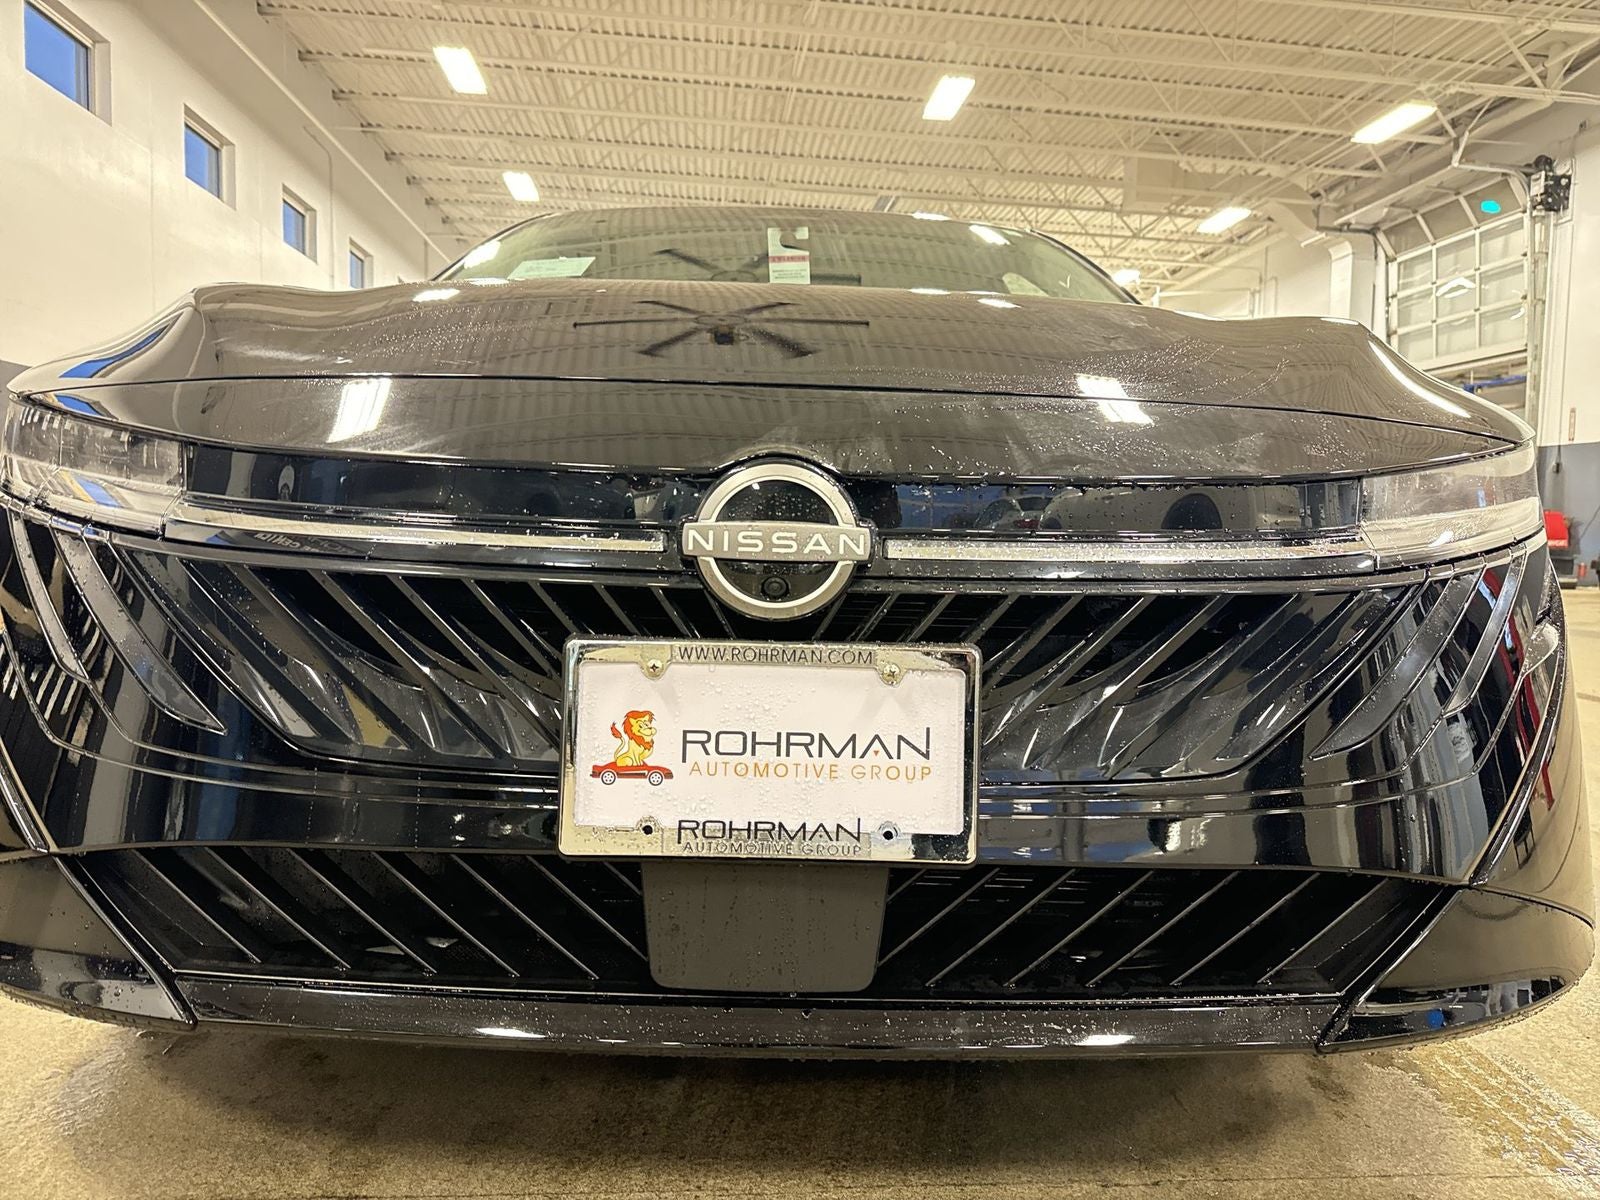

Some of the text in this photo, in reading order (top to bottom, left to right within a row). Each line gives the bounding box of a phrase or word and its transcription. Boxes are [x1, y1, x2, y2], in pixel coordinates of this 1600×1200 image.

[687, 529, 866, 556] NISSAN
[678, 646, 873, 665] WWW.ROHRMAN.COM
[681, 727, 930, 763] ROHRMAN
[689, 761, 932, 780] AUTOMOTIVE GROUP
[677, 817, 861, 844] ROHRMAN
[683, 841, 862, 856] AUTOMOTIVE GROUP
